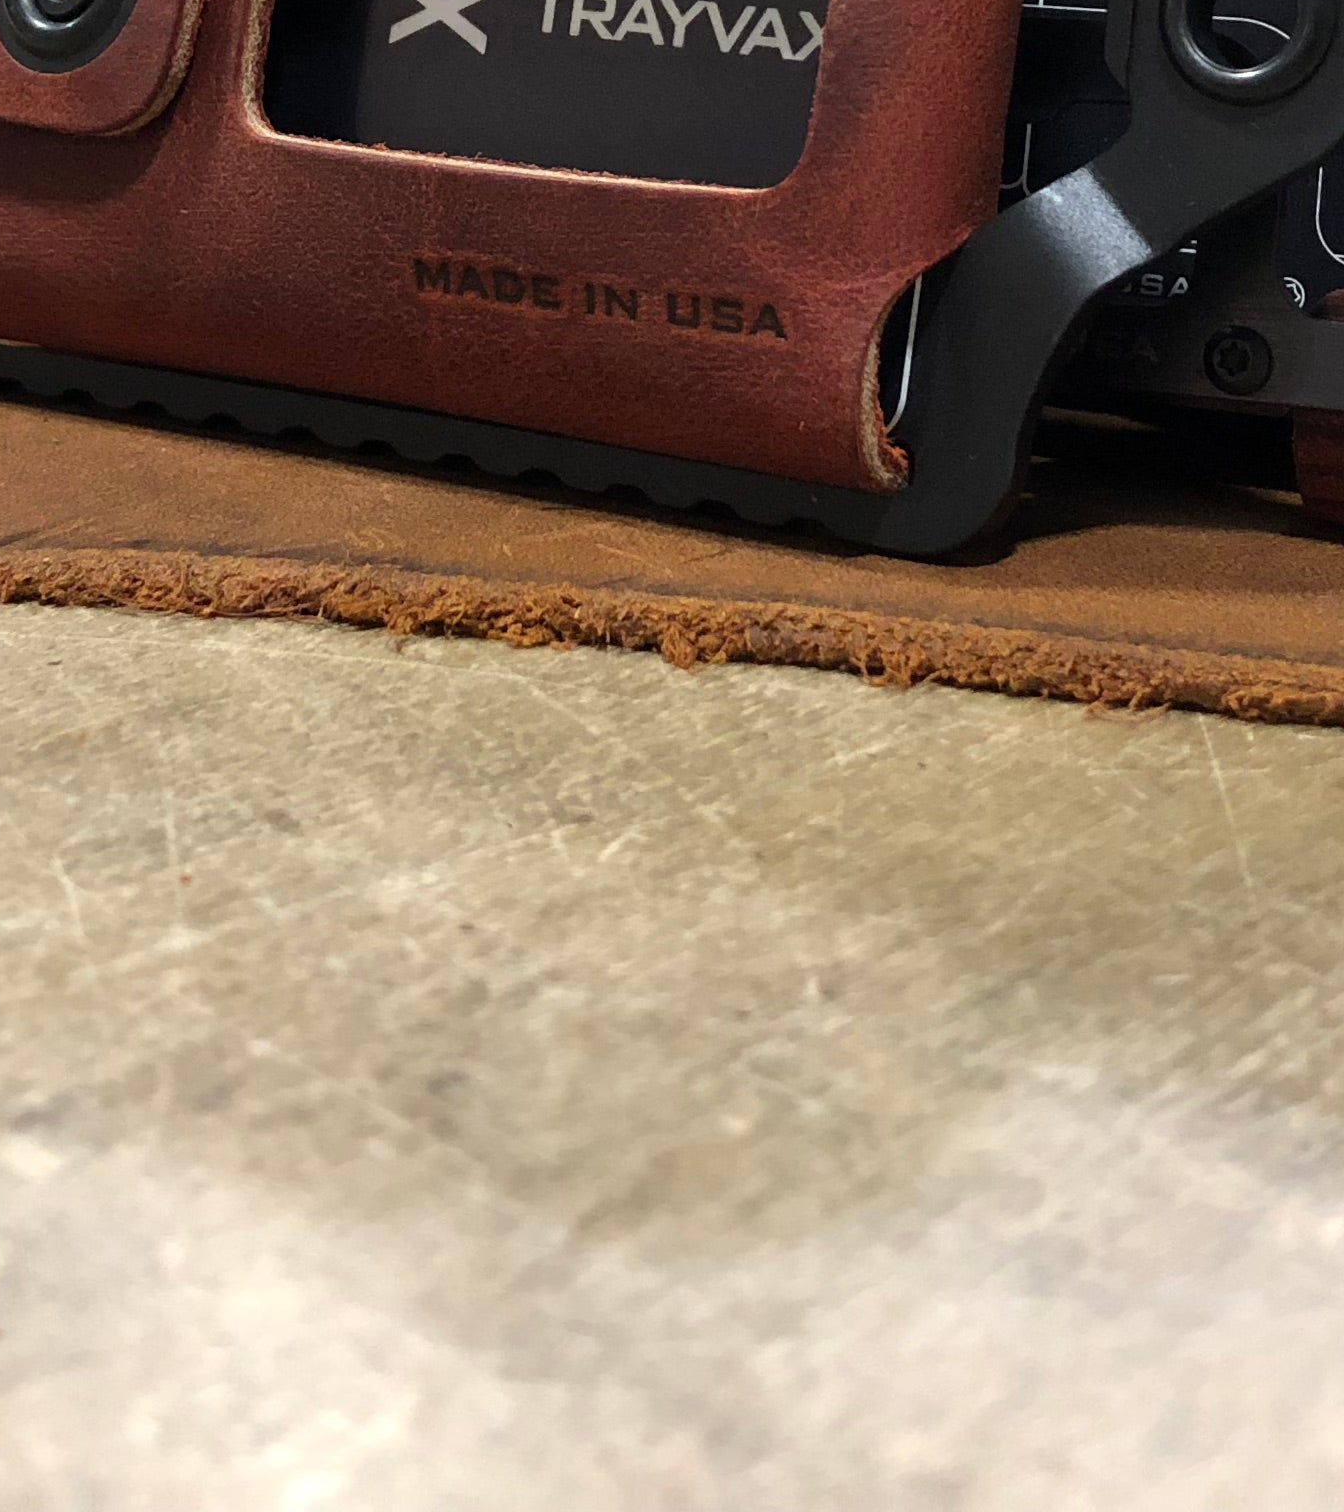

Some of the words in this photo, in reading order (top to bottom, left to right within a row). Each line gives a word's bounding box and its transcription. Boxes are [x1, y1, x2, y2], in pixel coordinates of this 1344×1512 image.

[413, 258, 562, 311] MADE
[584, 282, 639, 321] IN
[666, 292, 788, 341] USA
[1121, 272, 1189, 298] SA
